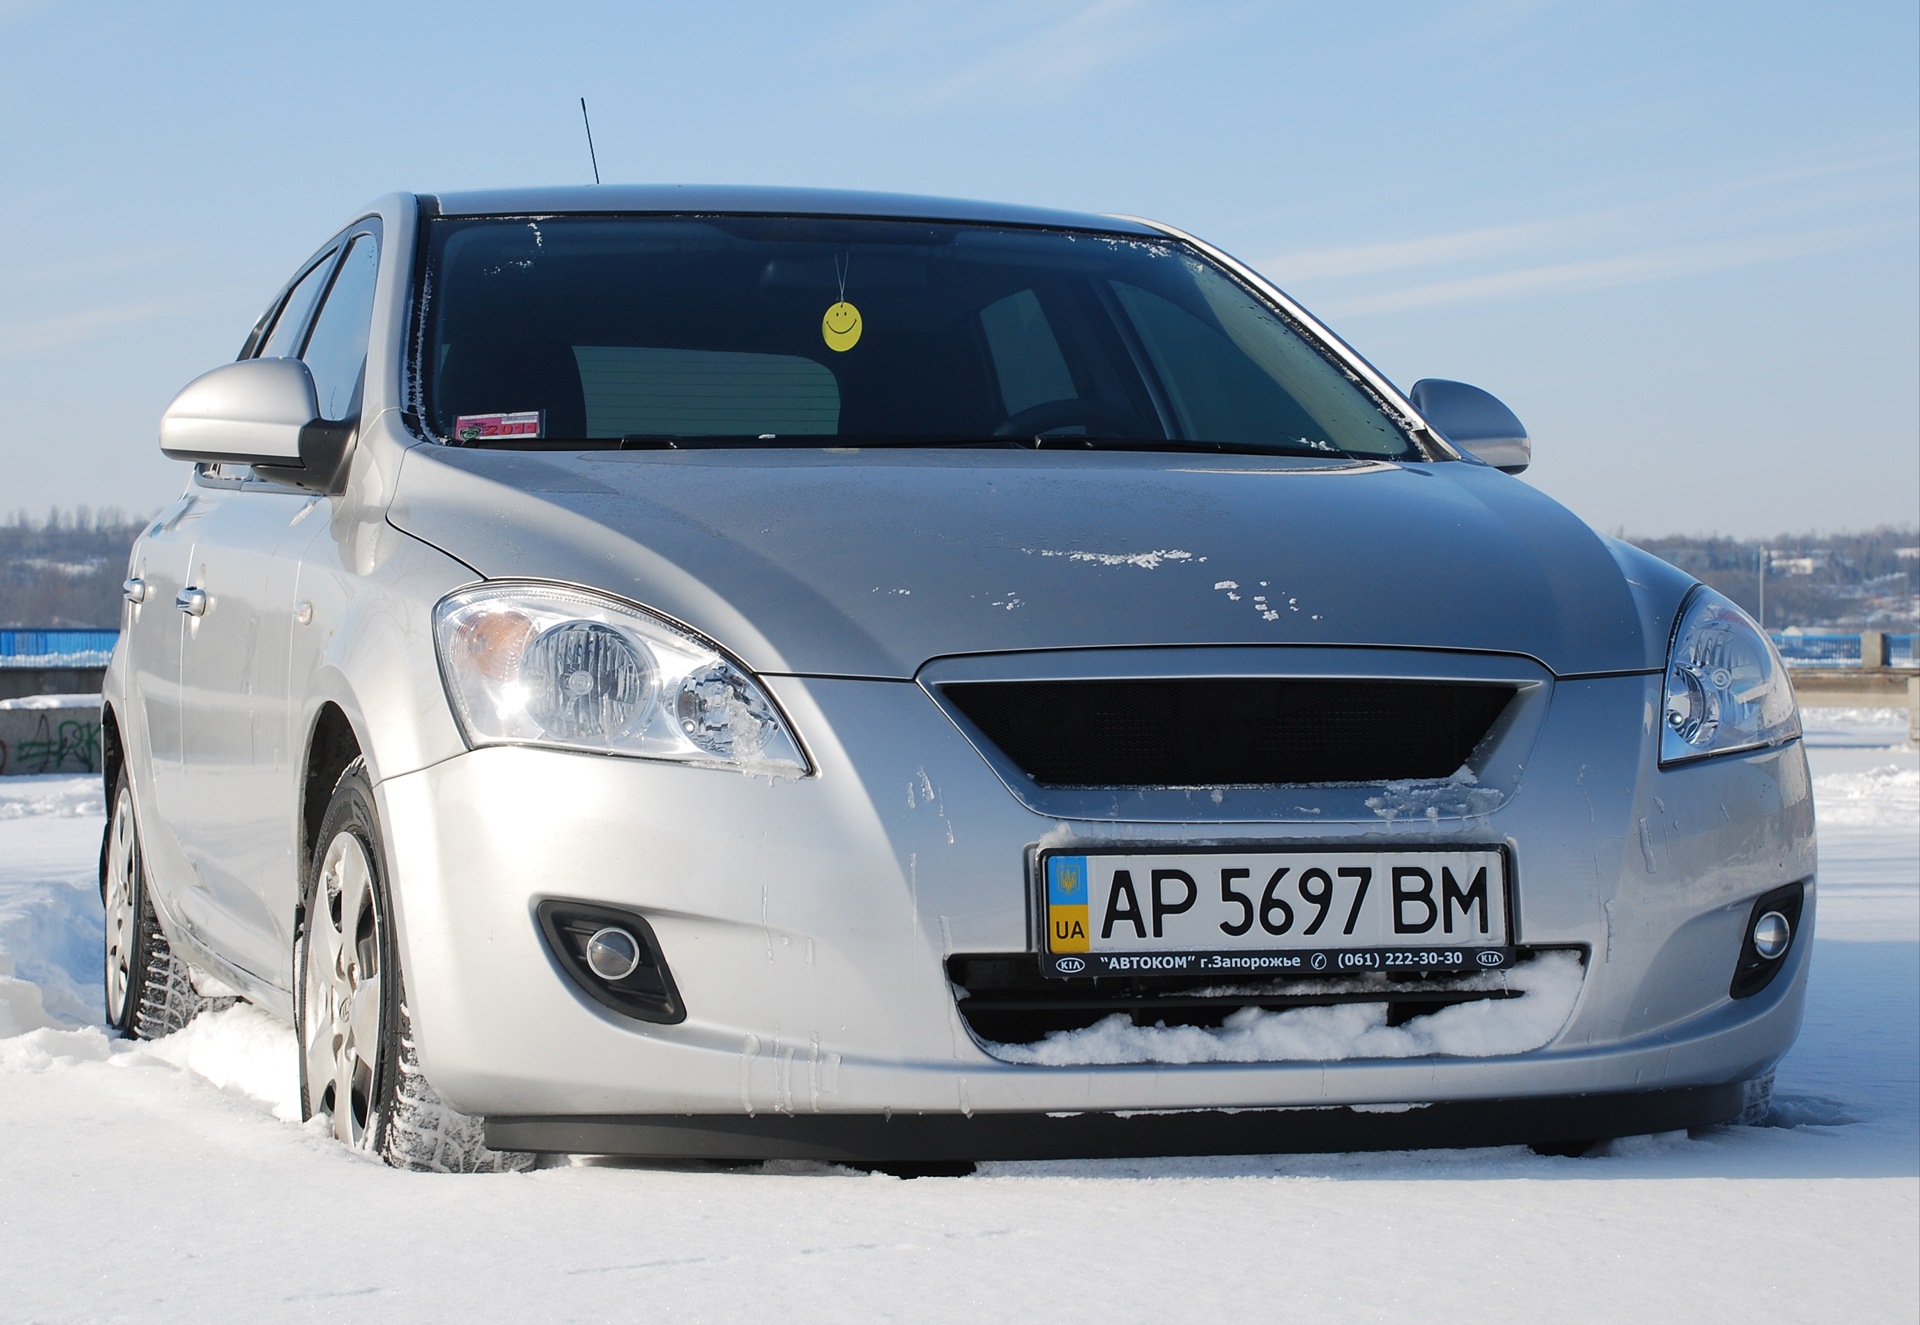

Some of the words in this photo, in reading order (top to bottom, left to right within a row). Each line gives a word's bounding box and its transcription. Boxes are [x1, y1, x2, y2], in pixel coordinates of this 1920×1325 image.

[484, 423, 537, 436] 2011
[1101, 869, 1198, 939] AP
[1219, 867, 1372, 937] 5697
[1392, 866, 1489, 935] BM
[1056, 920, 1085, 940] UA
[1060, 960, 1082, 971] KIA
[1200, 954, 1301, 971] г.Запорожье
[1337, 952, 1380, 969] (061)
[1385, 951, 1463, 966] 222-30-30
[1480, 953, 1500, 964] KIA
